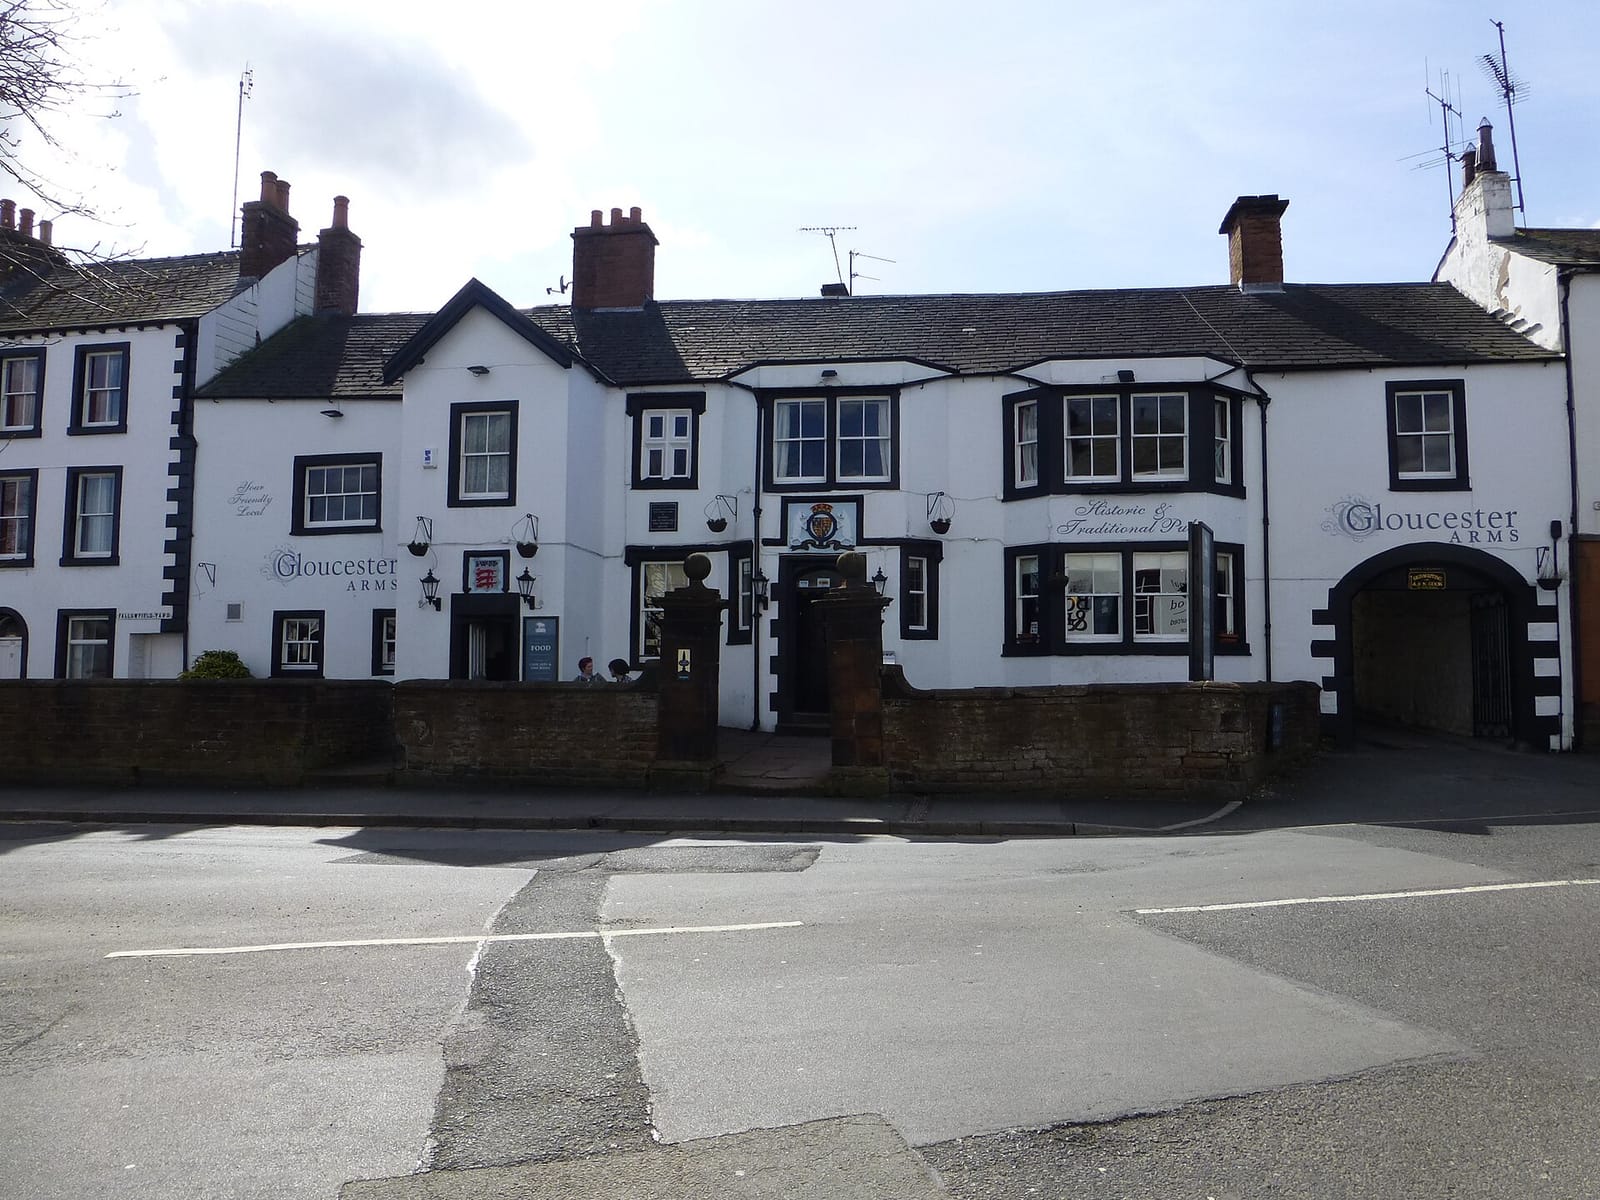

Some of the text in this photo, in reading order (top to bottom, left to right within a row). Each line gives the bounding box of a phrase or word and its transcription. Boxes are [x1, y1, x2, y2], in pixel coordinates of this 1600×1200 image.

[236, 481, 264, 493] Your
[227, 493, 273, 506] Friendly
[236, 505, 265, 517] Local
[1075, 500, 1173, 521] Historic &
[1346, 503, 1518, 532] Gloucester
[1056, 519, 1157, 536] Traditional
[1449, 529, 1519, 543] ARMS
[277, 552, 398, 577] Gloucester
[347, 579, 398, 592] ARMS
